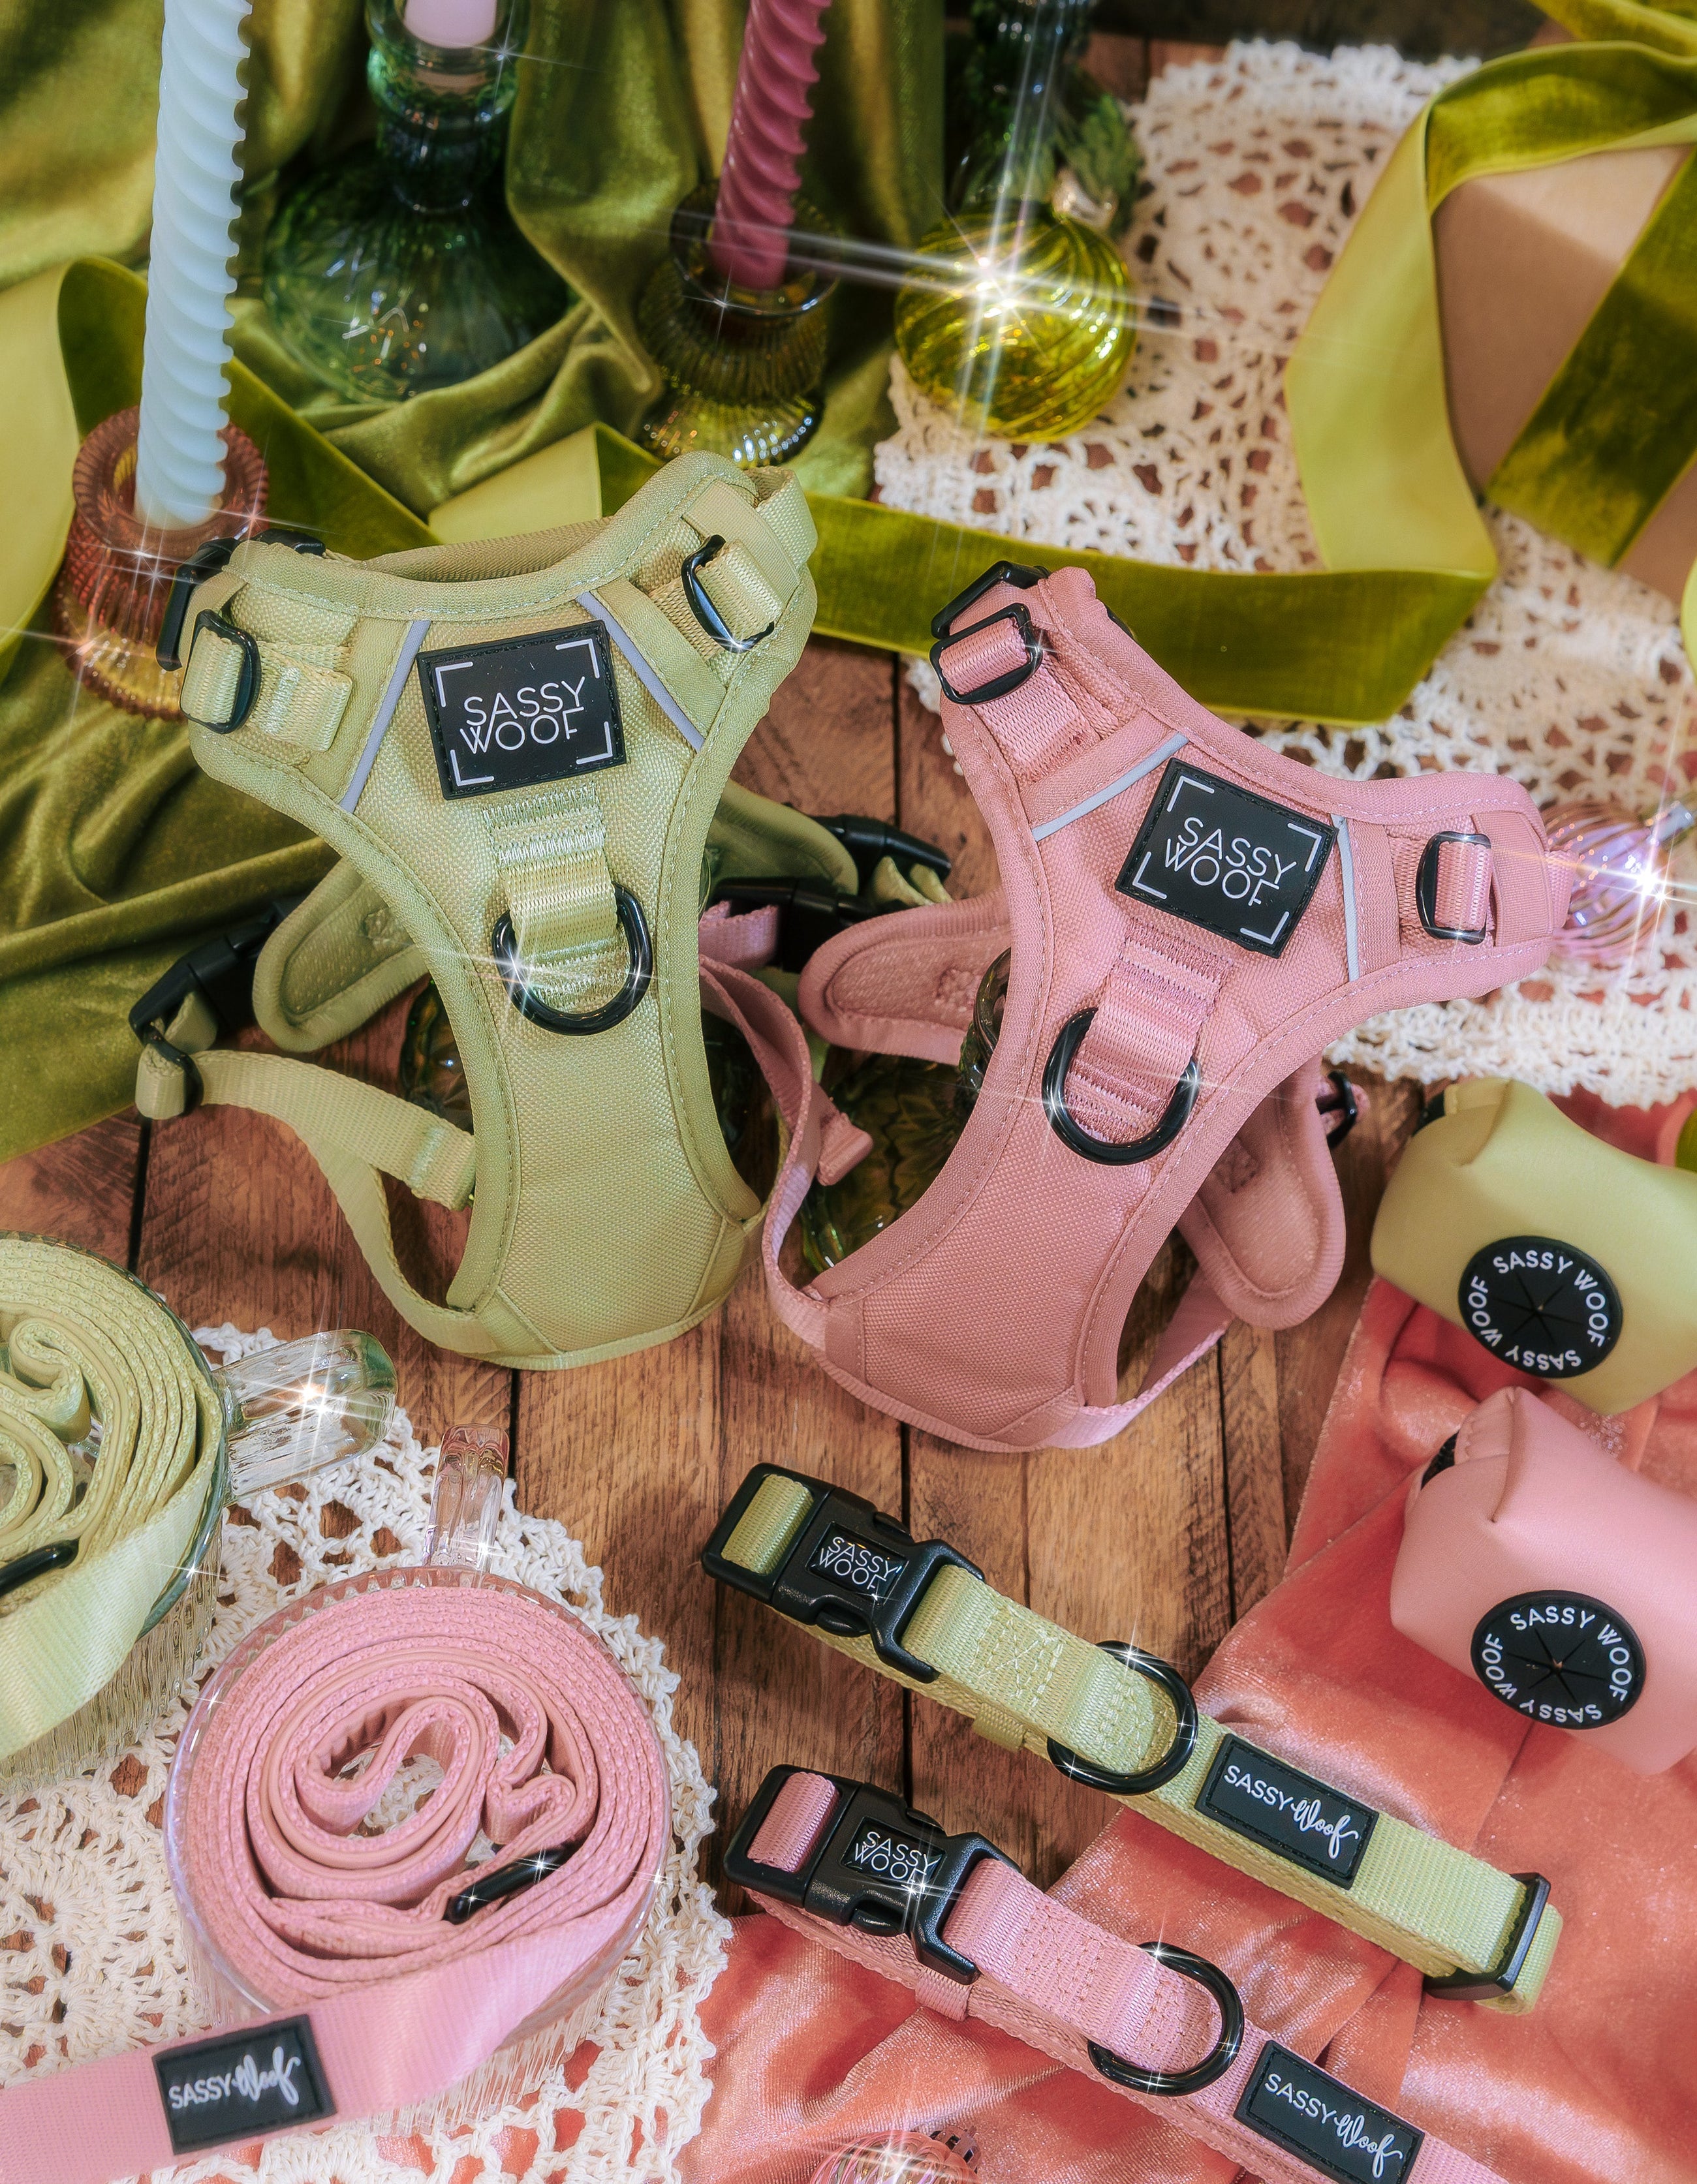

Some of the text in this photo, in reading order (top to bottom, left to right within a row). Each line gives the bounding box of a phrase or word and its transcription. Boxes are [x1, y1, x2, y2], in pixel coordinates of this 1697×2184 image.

[459, 706, 585, 754] WOOF
[463, 676, 585, 726] SASSY
[1165, 838, 1280, 906] WOOF
[1177, 817, 1297, 884] SASSY
[1468, 1275, 1581, 1371] SASSY WOOF
[1493, 1250, 1609, 1347] SASSY WOOF
[819, 1547, 887, 1590] WOOF
[828, 1537, 899, 1578] SASSY
[1482, 1633, 1602, 1723] SASSY WOOF
[1510, 1605, 1632, 1702] SASSY WOOF
[1224, 1765, 1360, 1860] SASSY Woof
[855, 1843, 927, 1884] WOOF
[862, 1831, 941, 1873] SASSY
[168, 2072, 232, 2109] SASSY
[1264, 2073, 1403, 2179] SASSY Woof
